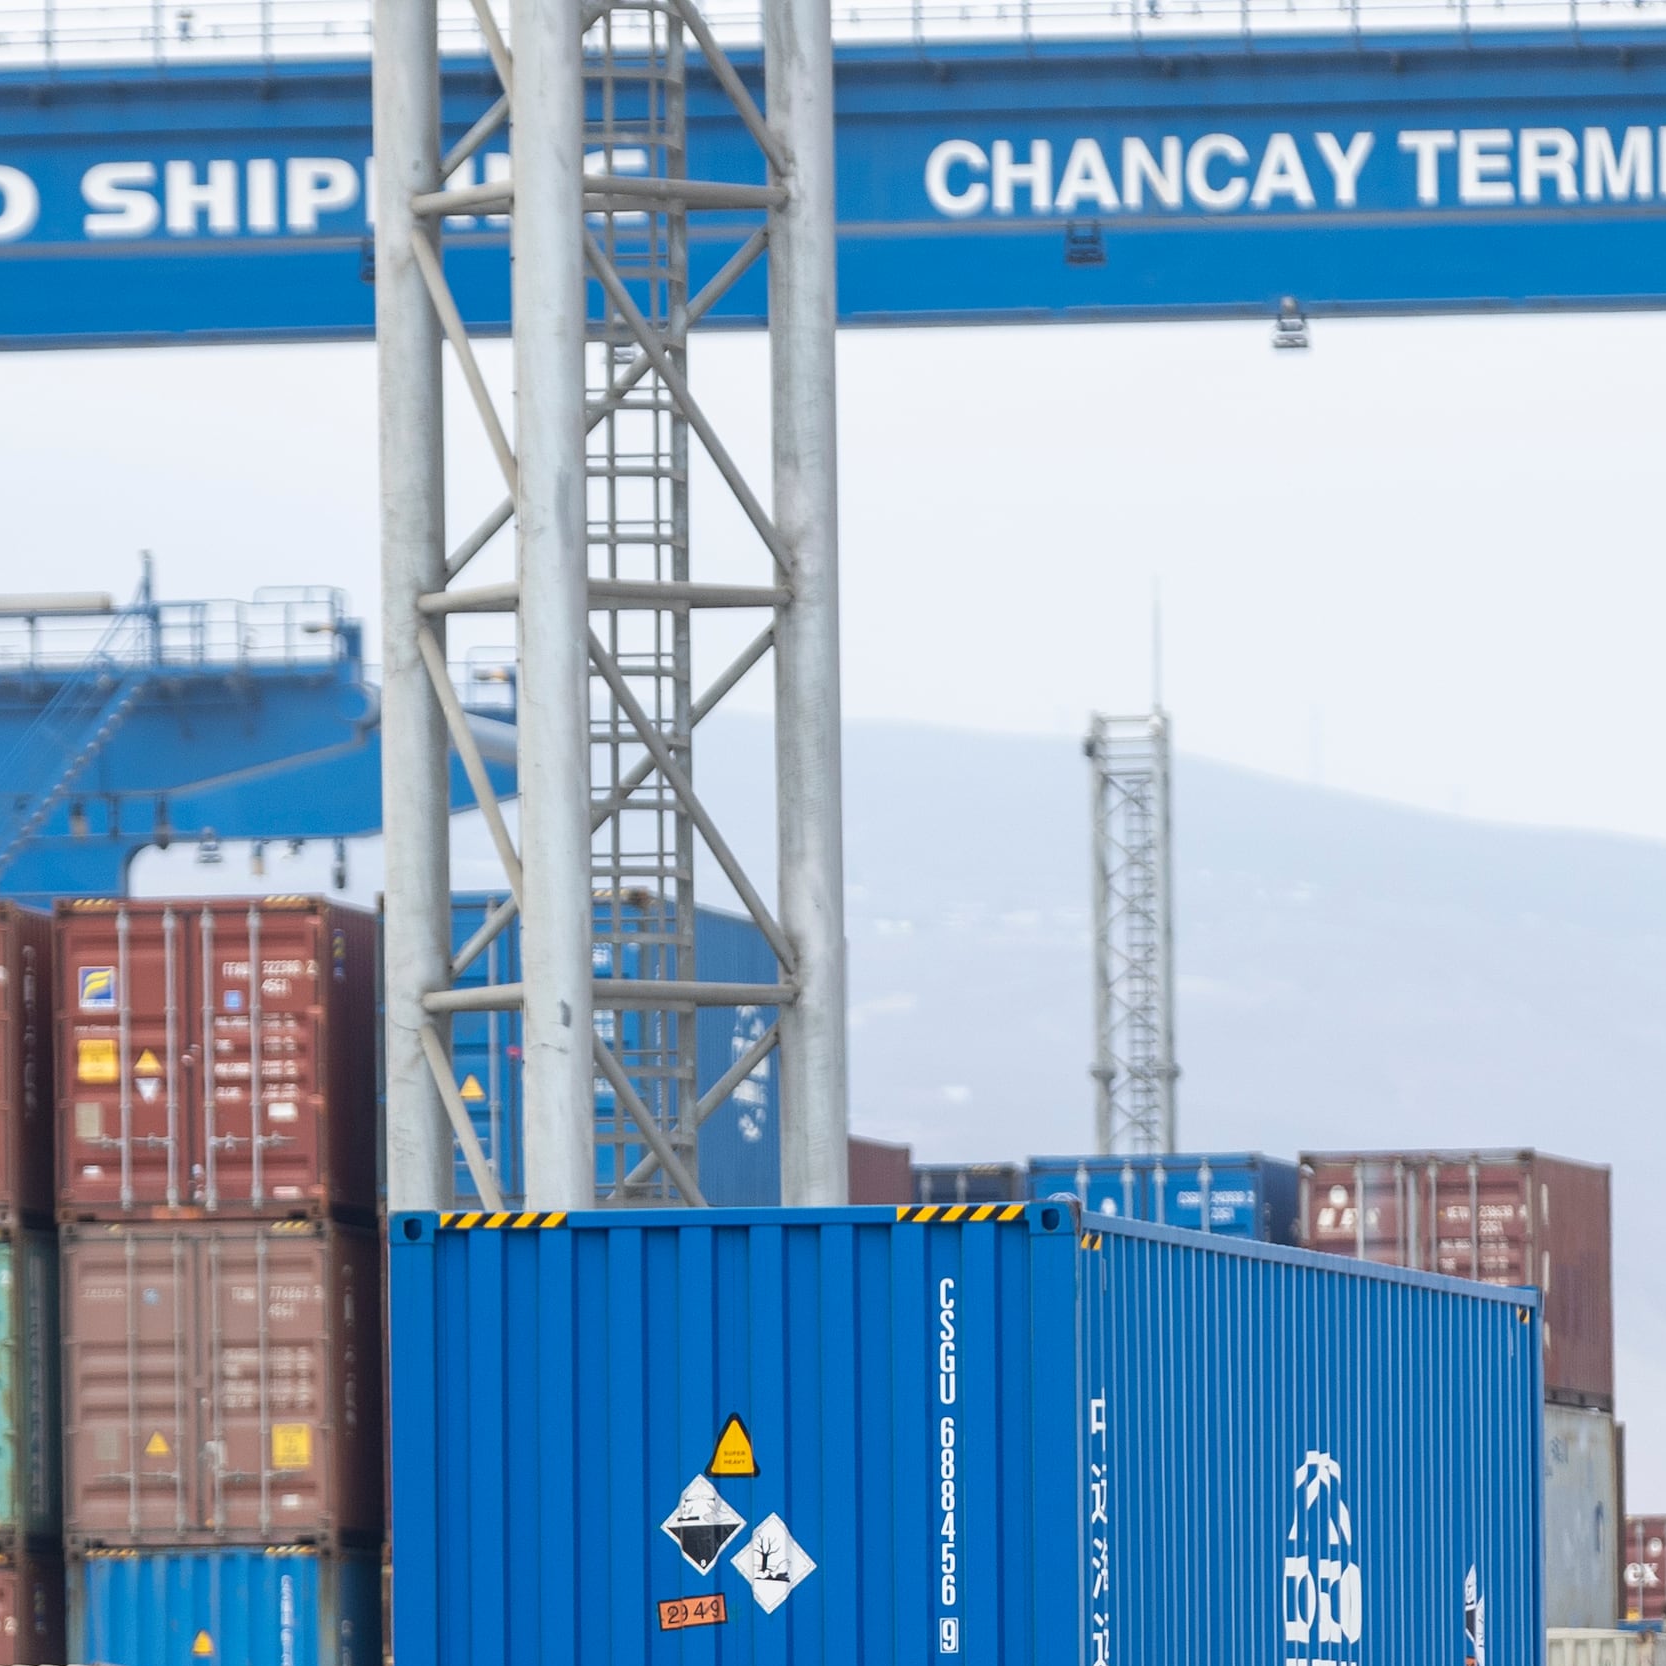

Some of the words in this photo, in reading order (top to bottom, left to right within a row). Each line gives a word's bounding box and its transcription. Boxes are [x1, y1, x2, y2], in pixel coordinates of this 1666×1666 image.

[79, 147, 649, 240] SHIPI
[925, 131, 1374, 216] CHANCAY
[939, 1277, 956, 1405] CSGU
[940, 1416, 956, 1606] 688456
[667, 1600, 721, 1624] 2949
[1623, 1562, 1660, 1585] ex
[942, 1621, 956, 1650] 9
